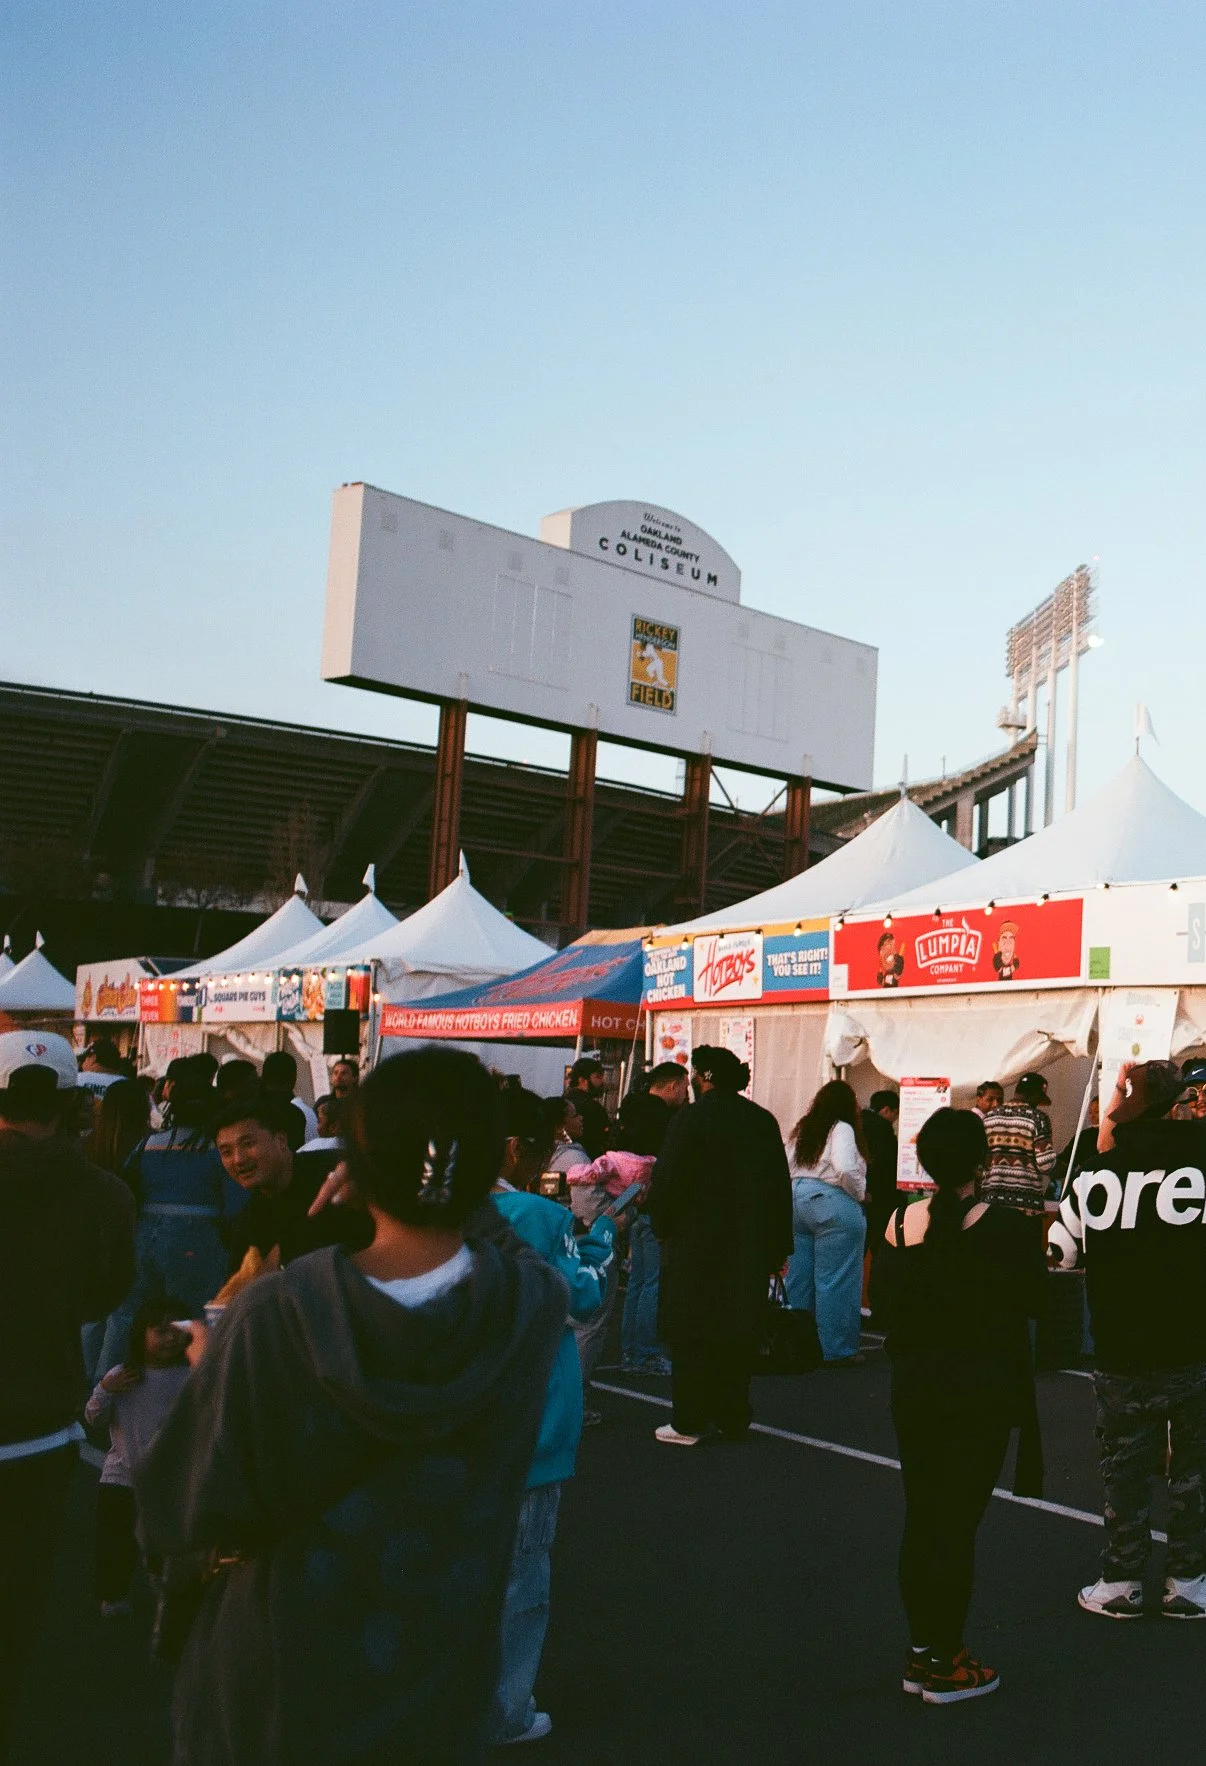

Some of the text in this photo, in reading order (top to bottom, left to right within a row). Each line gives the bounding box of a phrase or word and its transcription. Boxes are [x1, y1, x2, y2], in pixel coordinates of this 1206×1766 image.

[640, 524, 683, 546] OAKLAND
[620, 529, 700, 563] ALAMEDA COUNTY
[598, 537, 718, 586] COLISEUM
[635, 619, 677, 641] RICKEY
[631, 683, 674, 710] FIELD
[941, 917, 954, 928] THE
[767, 947, 828, 967] THAT'S RIGHT!
[919, 932, 976, 961] LUMPIA
[644, 956, 687, 977] OAKLAND
[773, 962, 821, 977] YOU SEE IT!
[929, 963, 964, 975] COMPANY
[250, 991, 266, 1001] GUYS
[646, 984, 686, 1004] CHICKEN
[455, 1011, 500, 1031] HOTBOYS
[501, 1011, 530, 1030] FRIED
[531, 1009, 578, 1029] CHICKEN
[591, 1015, 622, 1029] HOT
